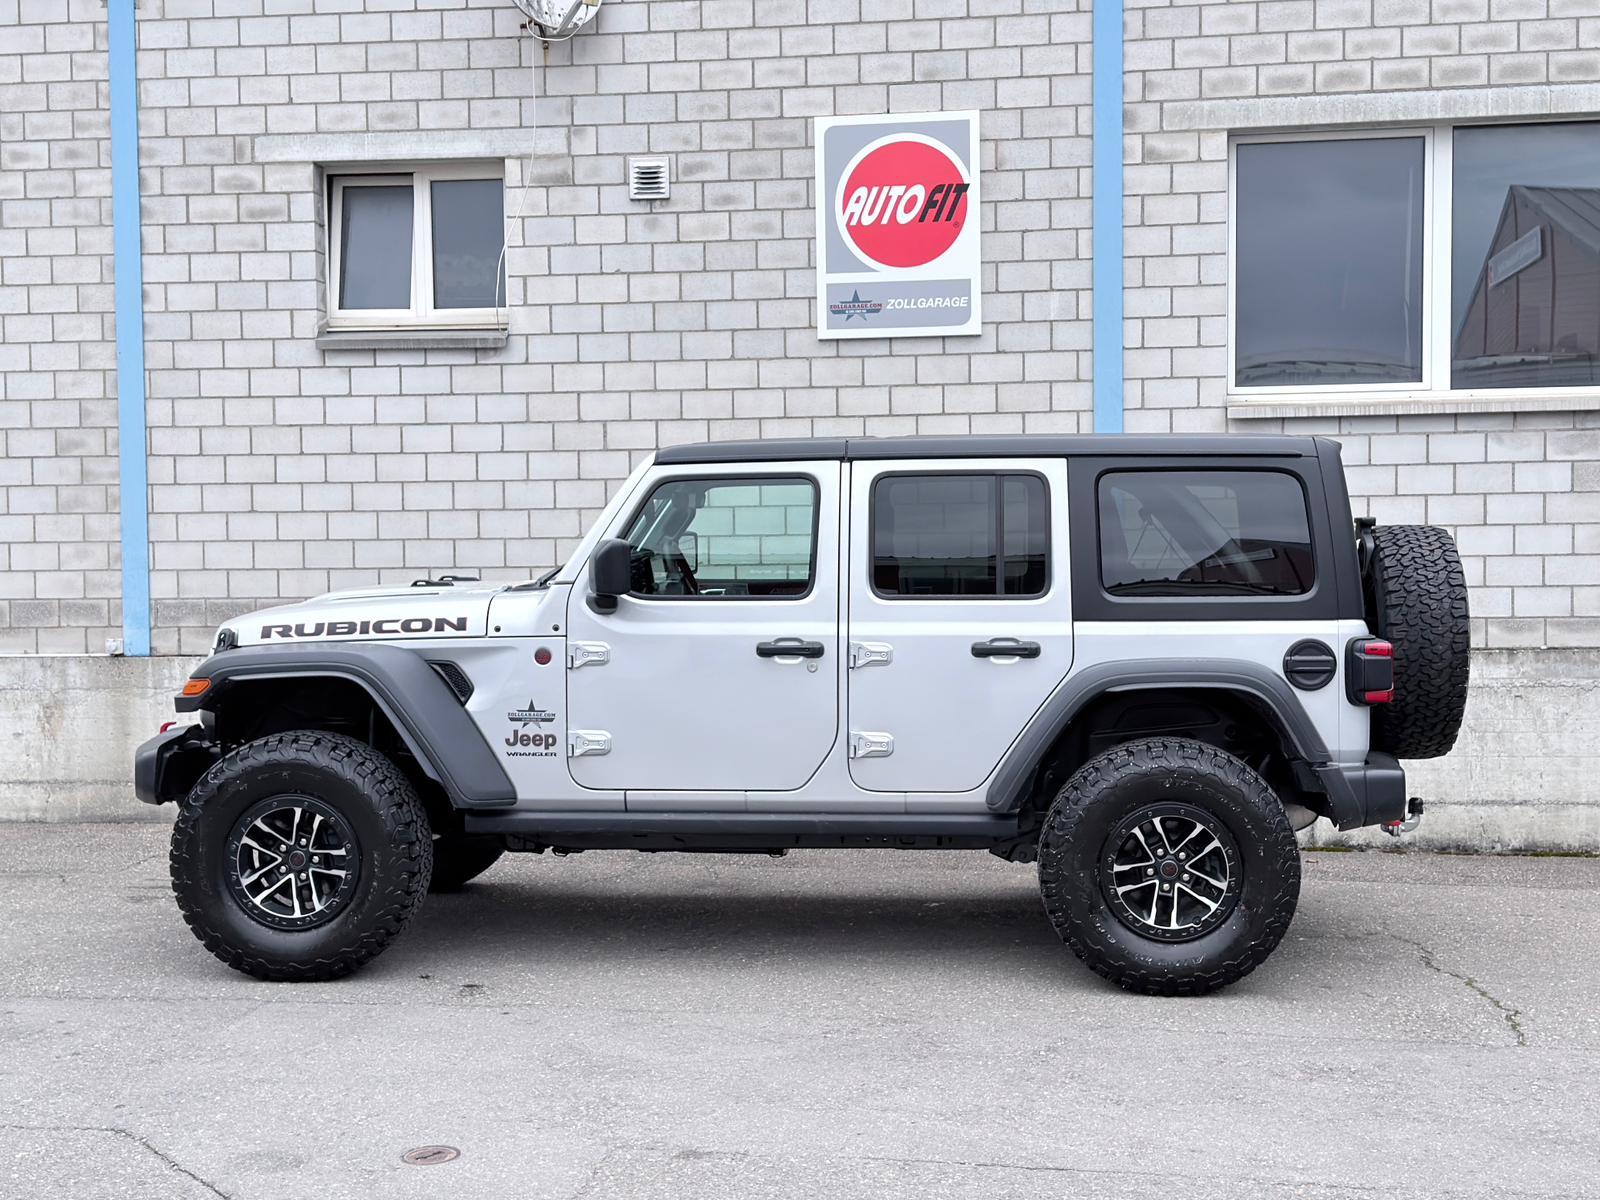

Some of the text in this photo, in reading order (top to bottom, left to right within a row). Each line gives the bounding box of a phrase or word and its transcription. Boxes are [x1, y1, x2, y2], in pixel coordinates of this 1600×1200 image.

[886, 297, 968, 309] ZOLLGARAGE
[261, 617, 467, 639] RUBICON
[505, 729, 557, 750] Jeep
